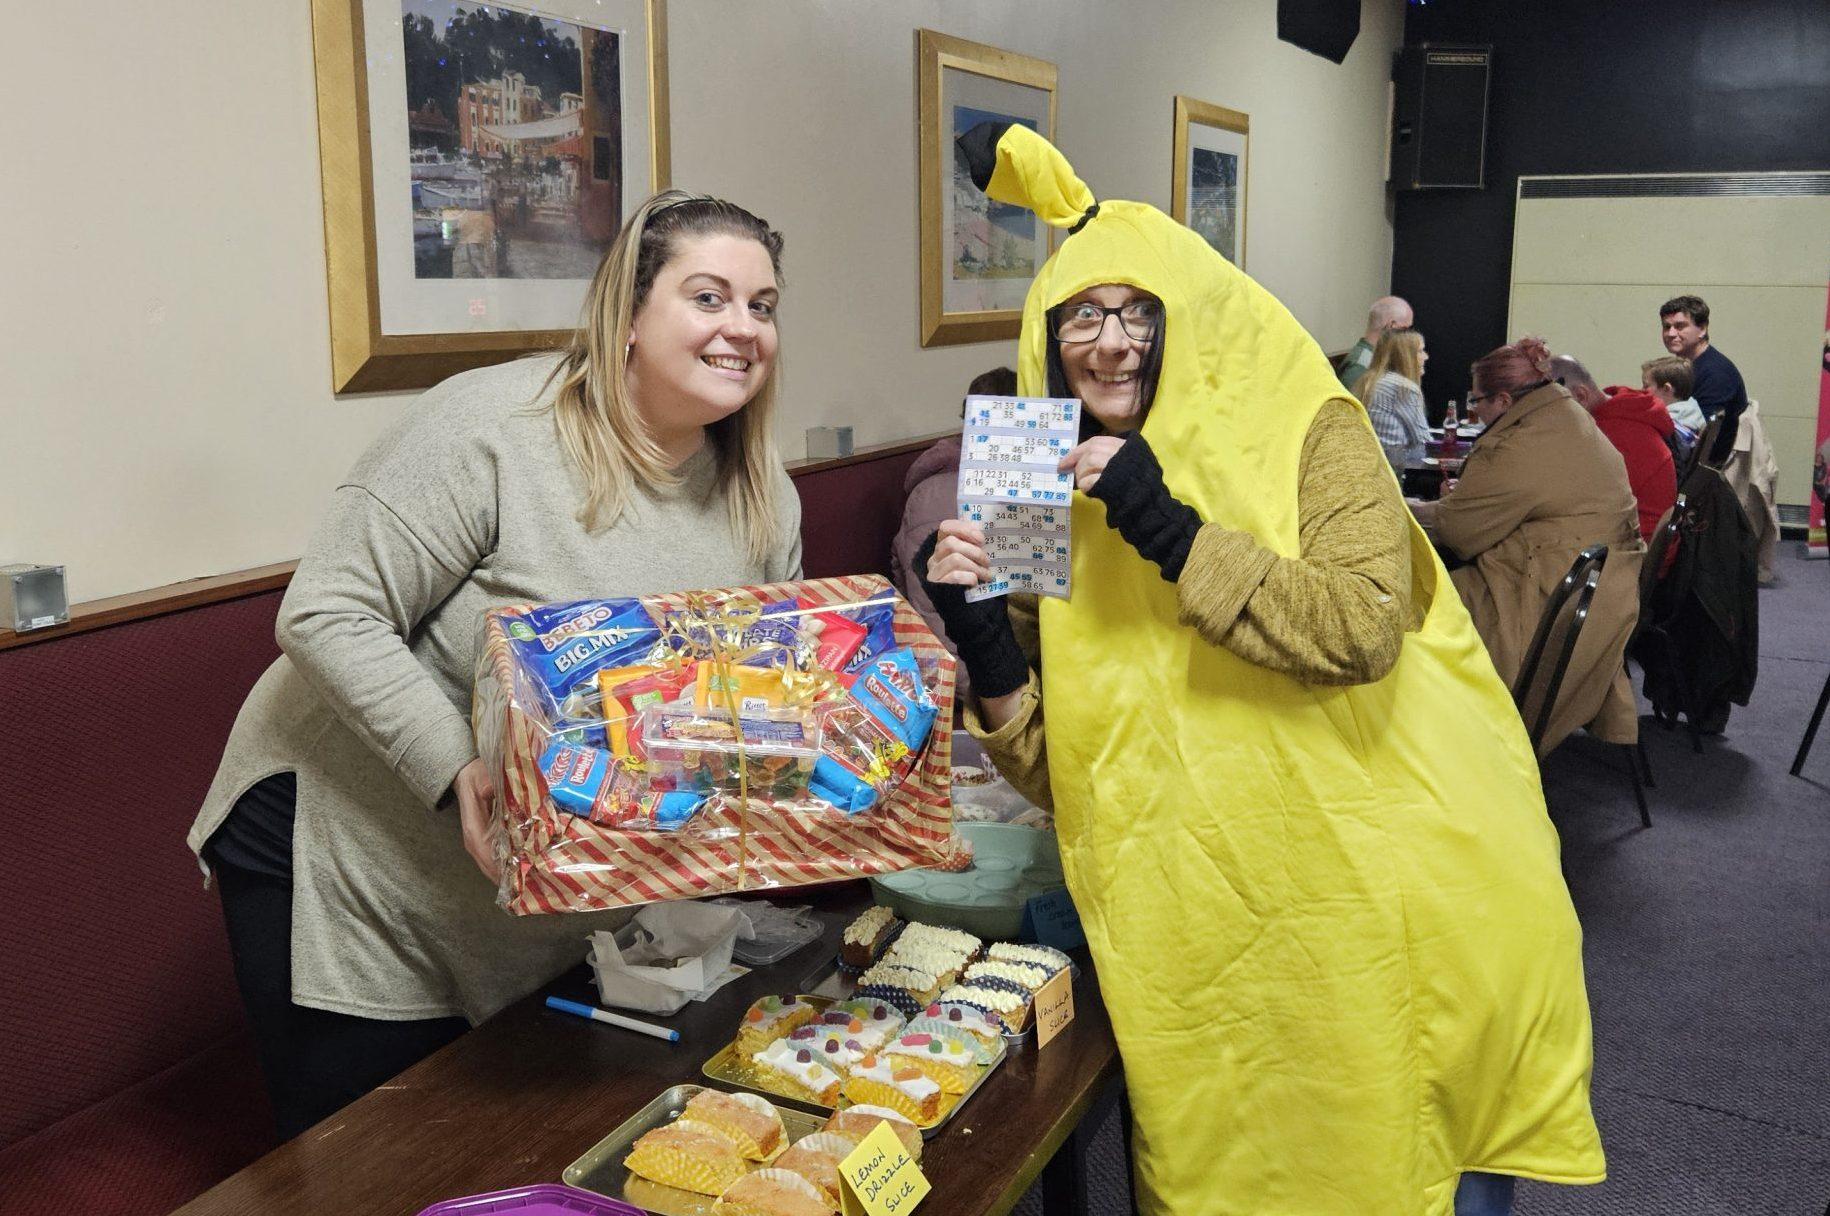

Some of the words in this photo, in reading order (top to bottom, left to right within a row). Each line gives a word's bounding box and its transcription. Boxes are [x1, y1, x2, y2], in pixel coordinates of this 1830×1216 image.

[542, 607, 612, 651] BEBETO
[554, 643, 590, 673] BIG
[588, 625, 628, 652] MIX
[864, 676, 906, 721] Roulette
[570, 748, 598, 784] Roulette
[1038, 991, 1069, 1019] VANILLA
[1049, 1008, 1068, 1032] SLICE
[851, 1146, 886, 1189] LEMON
[865, 1154, 912, 1203] DRIZZLE
[885, 1181, 915, 1213] SLICE
